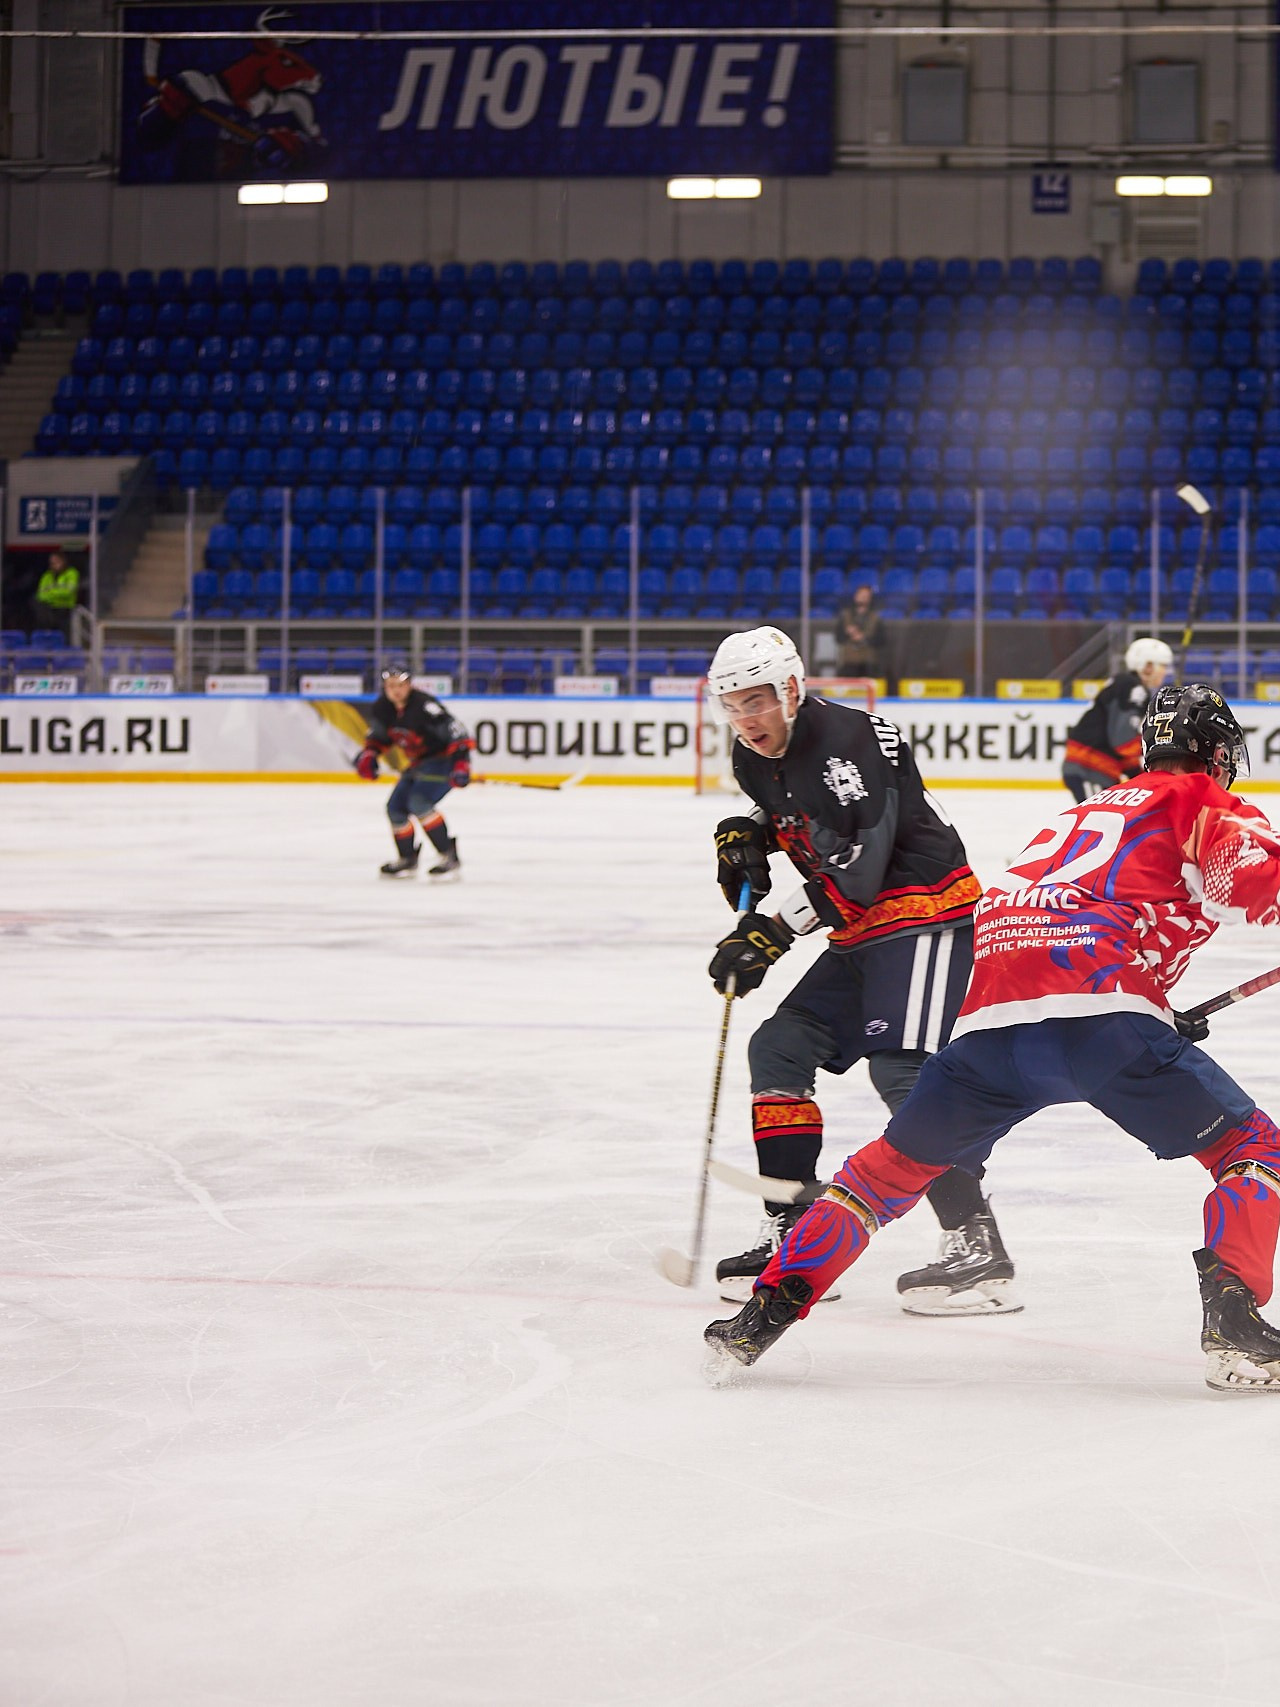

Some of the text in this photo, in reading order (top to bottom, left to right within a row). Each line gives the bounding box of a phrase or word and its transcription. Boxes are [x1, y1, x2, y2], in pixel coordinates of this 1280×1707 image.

[378, 43, 801, 130] ЛЮТЫЕ!
[0, 718, 190, 754] LIGA.RU
[978, 915, 1051, 935] ИВАНОВСКАЯ
[993, 941, 1015, 954] ГПС
[1017, 939, 1045, 950] МЧС
[1046, 936, 1096, 948] РОССИИ
